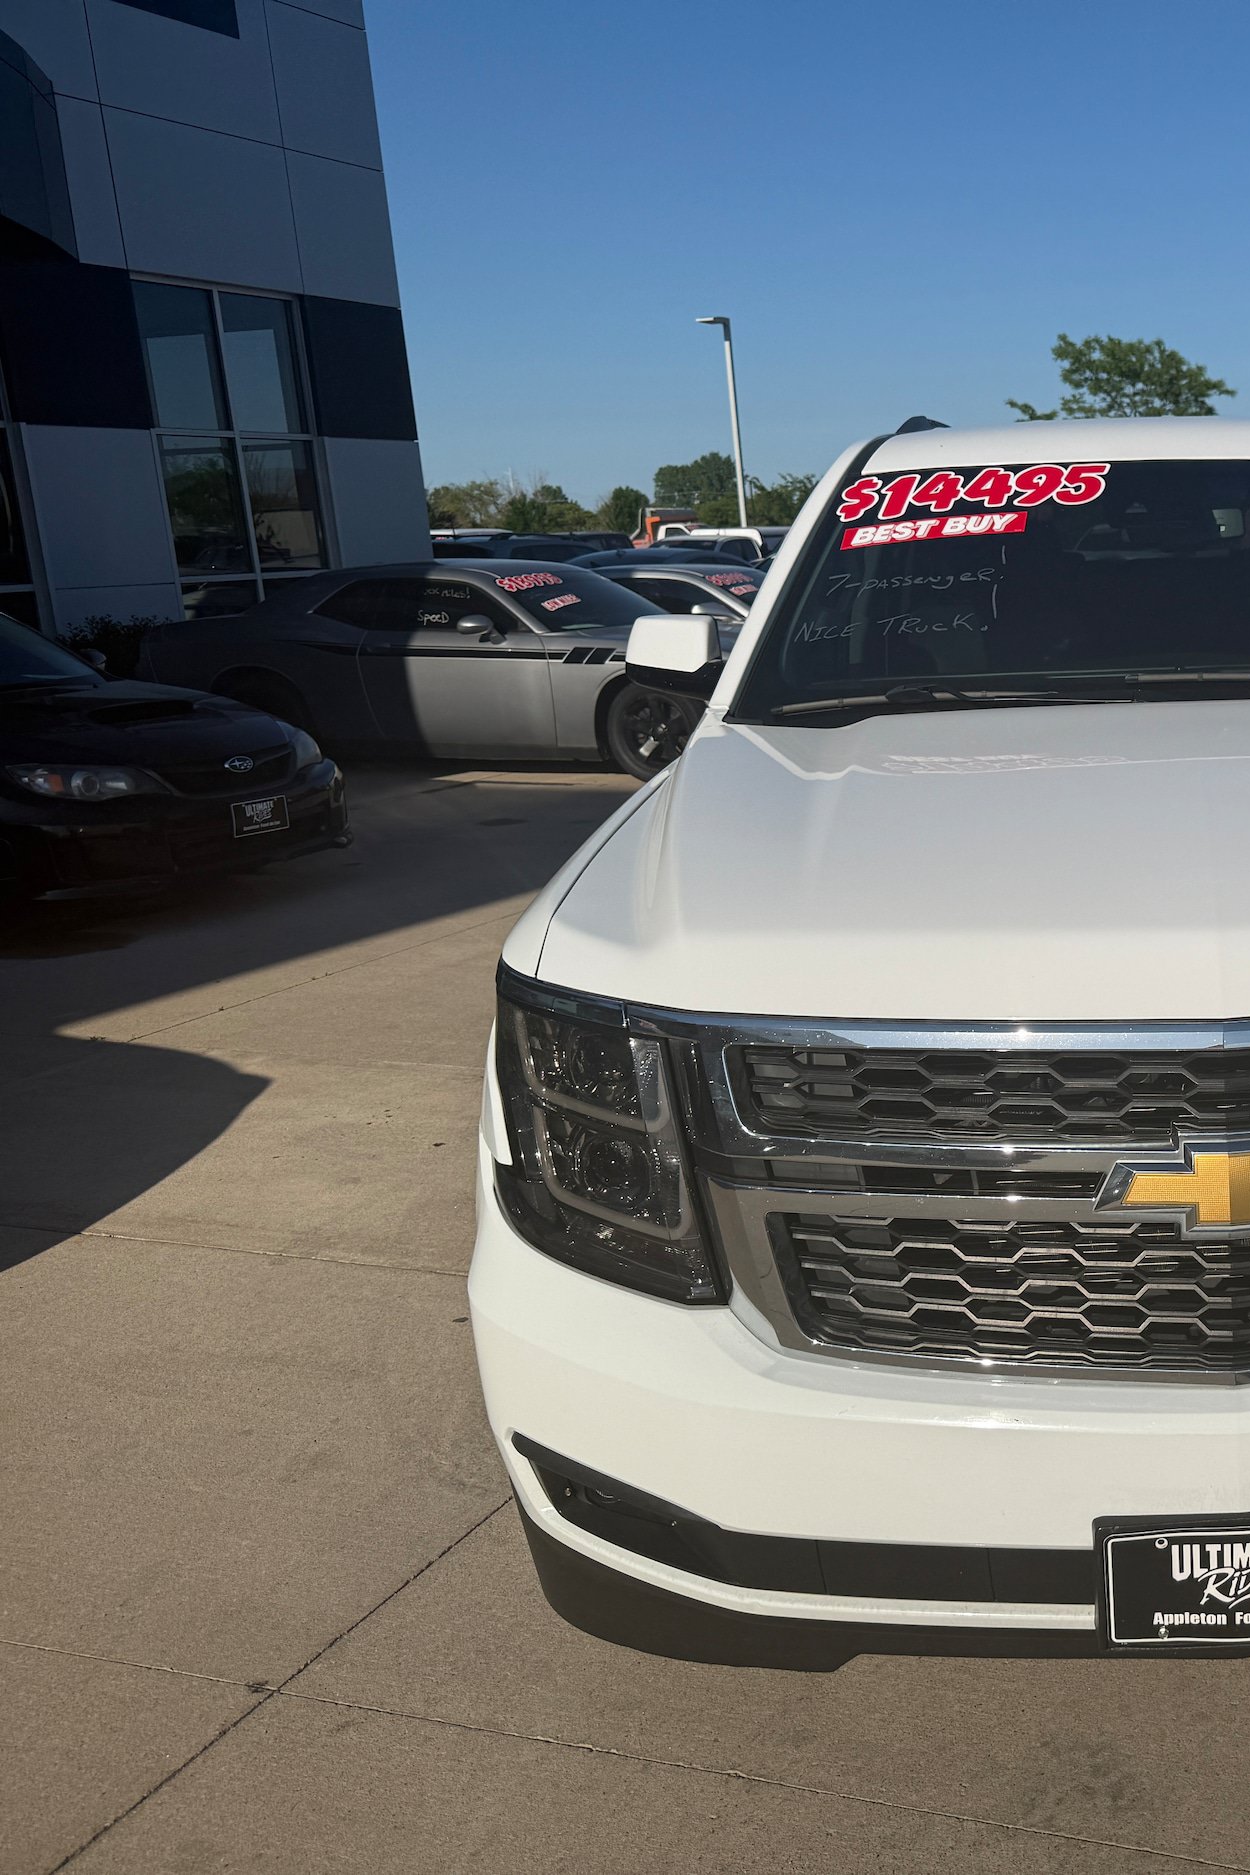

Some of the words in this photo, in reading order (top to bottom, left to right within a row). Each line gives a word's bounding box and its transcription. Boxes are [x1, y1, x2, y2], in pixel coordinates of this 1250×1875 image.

[837, 464, 1111, 522] $14495
[851, 519, 939, 546] BEST
[942, 513, 1018, 535] BUY
[794, 621, 863, 643] NICE
[1153, 1611, 1227, 1626] Appleton
